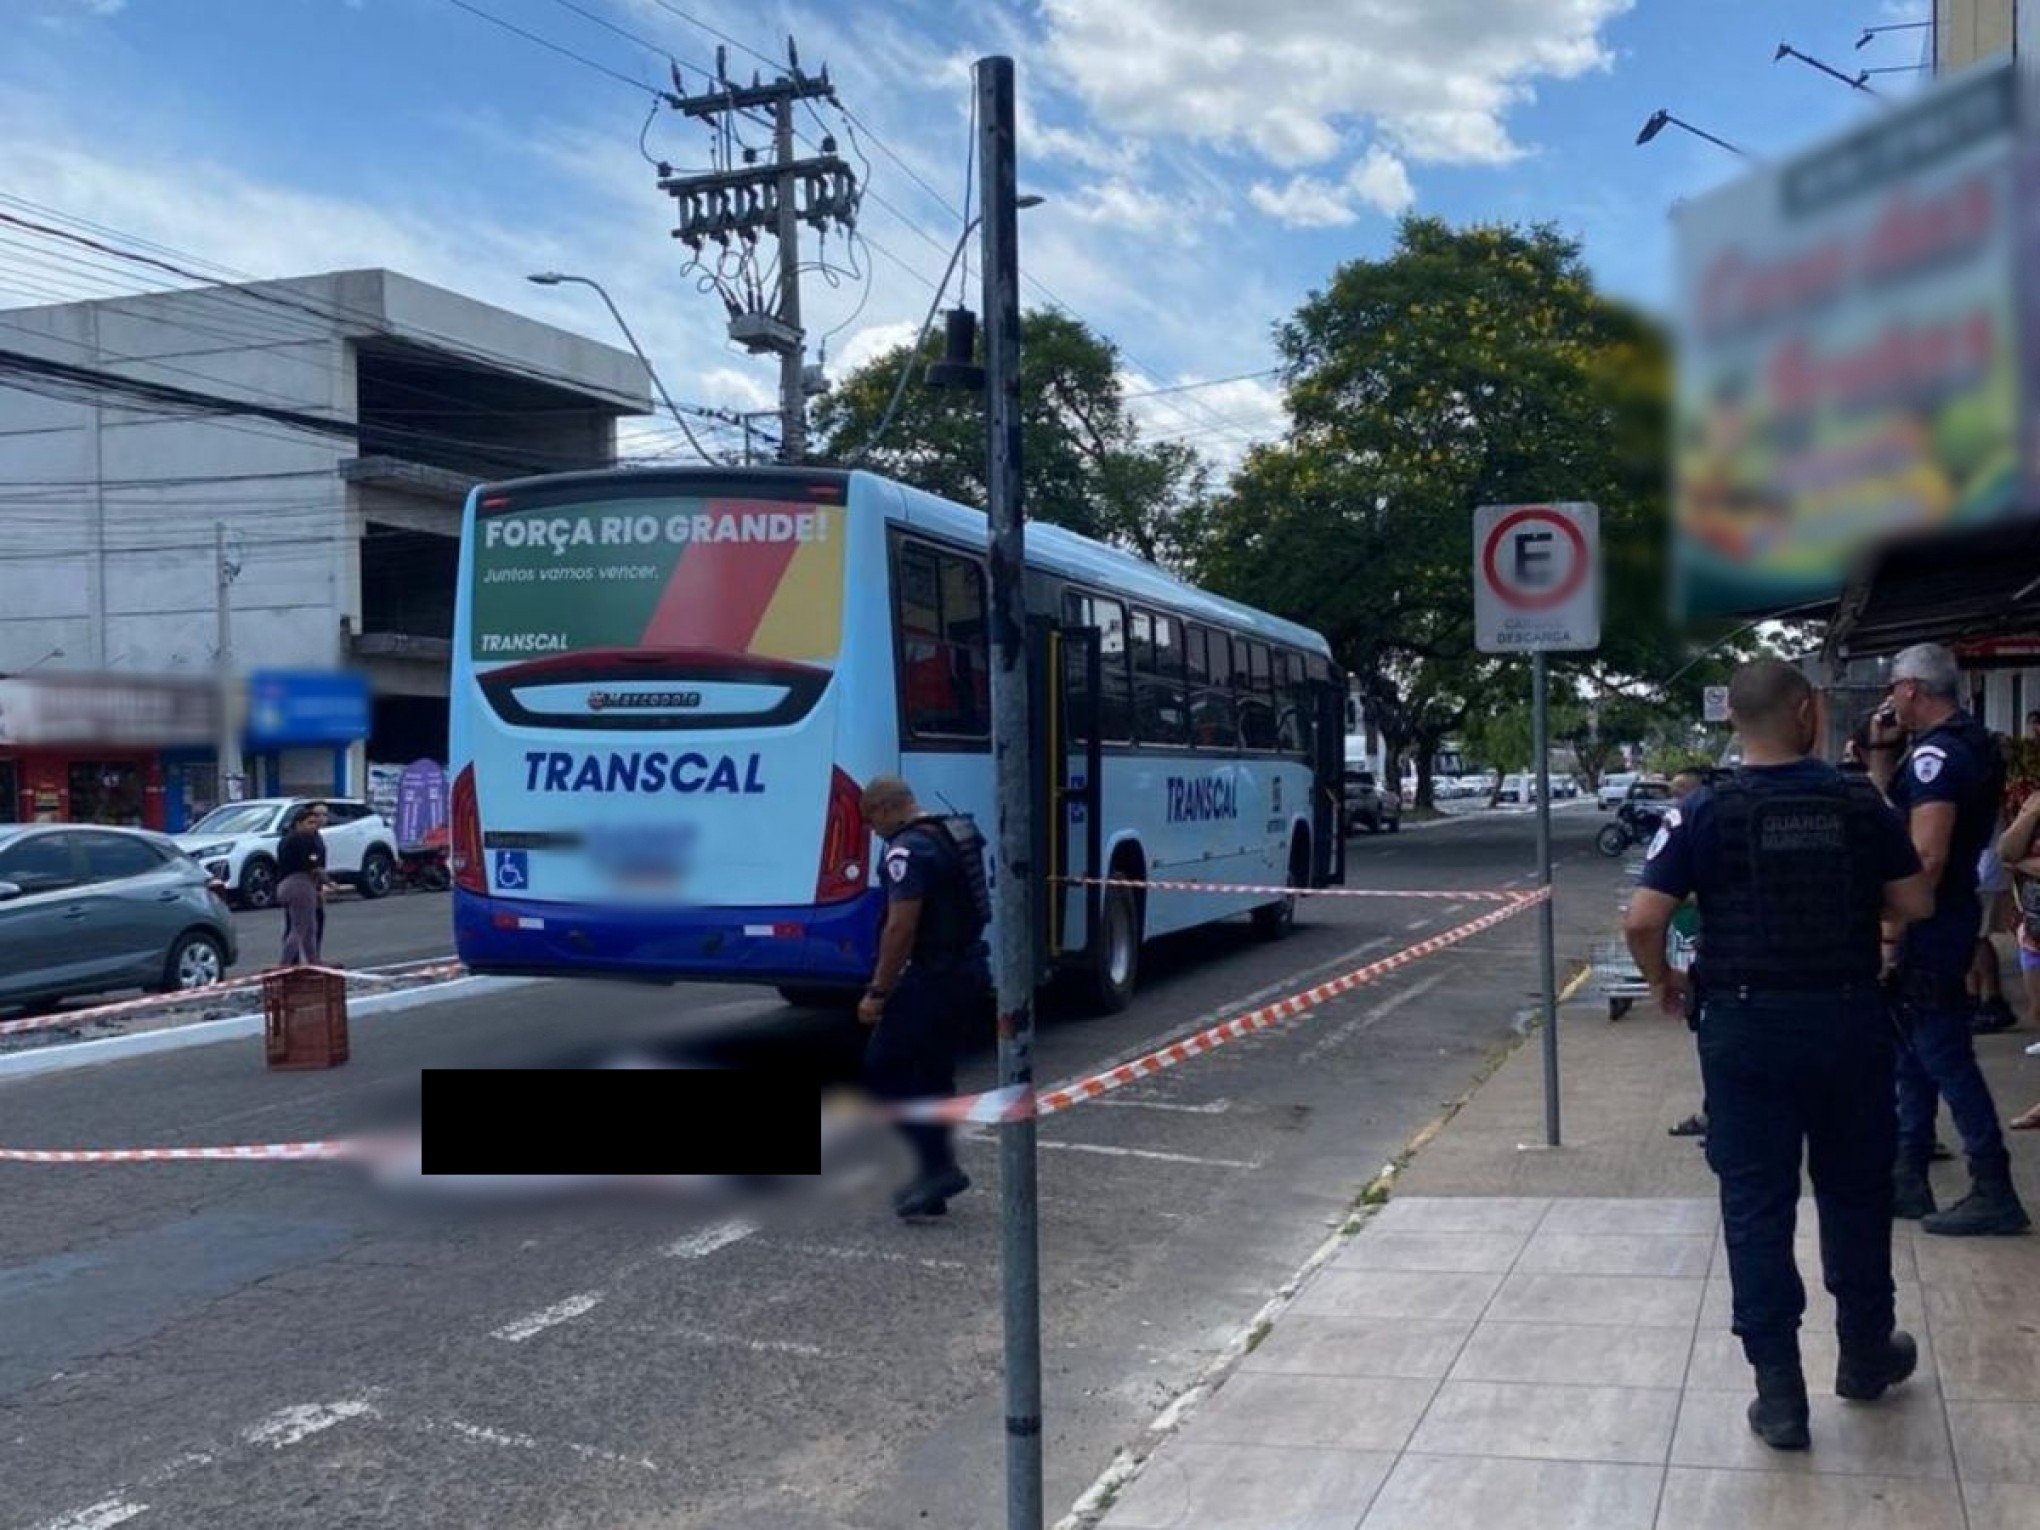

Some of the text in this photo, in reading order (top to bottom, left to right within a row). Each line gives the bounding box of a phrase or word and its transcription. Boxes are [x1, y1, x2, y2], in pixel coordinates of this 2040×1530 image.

[485, 514, 829, 556] FORÇA RIO GRANDE!
[484, 567, 535, 584] Juntos
[539, 566, 594, 582] vamos
[1515, 532, 1552, 584] E
[481, 633, 569, 652] TRANSCAL
[525, 750, 766, 794] TRANSCAL
[1167, 775, 1238, 823] TRANSCAL
